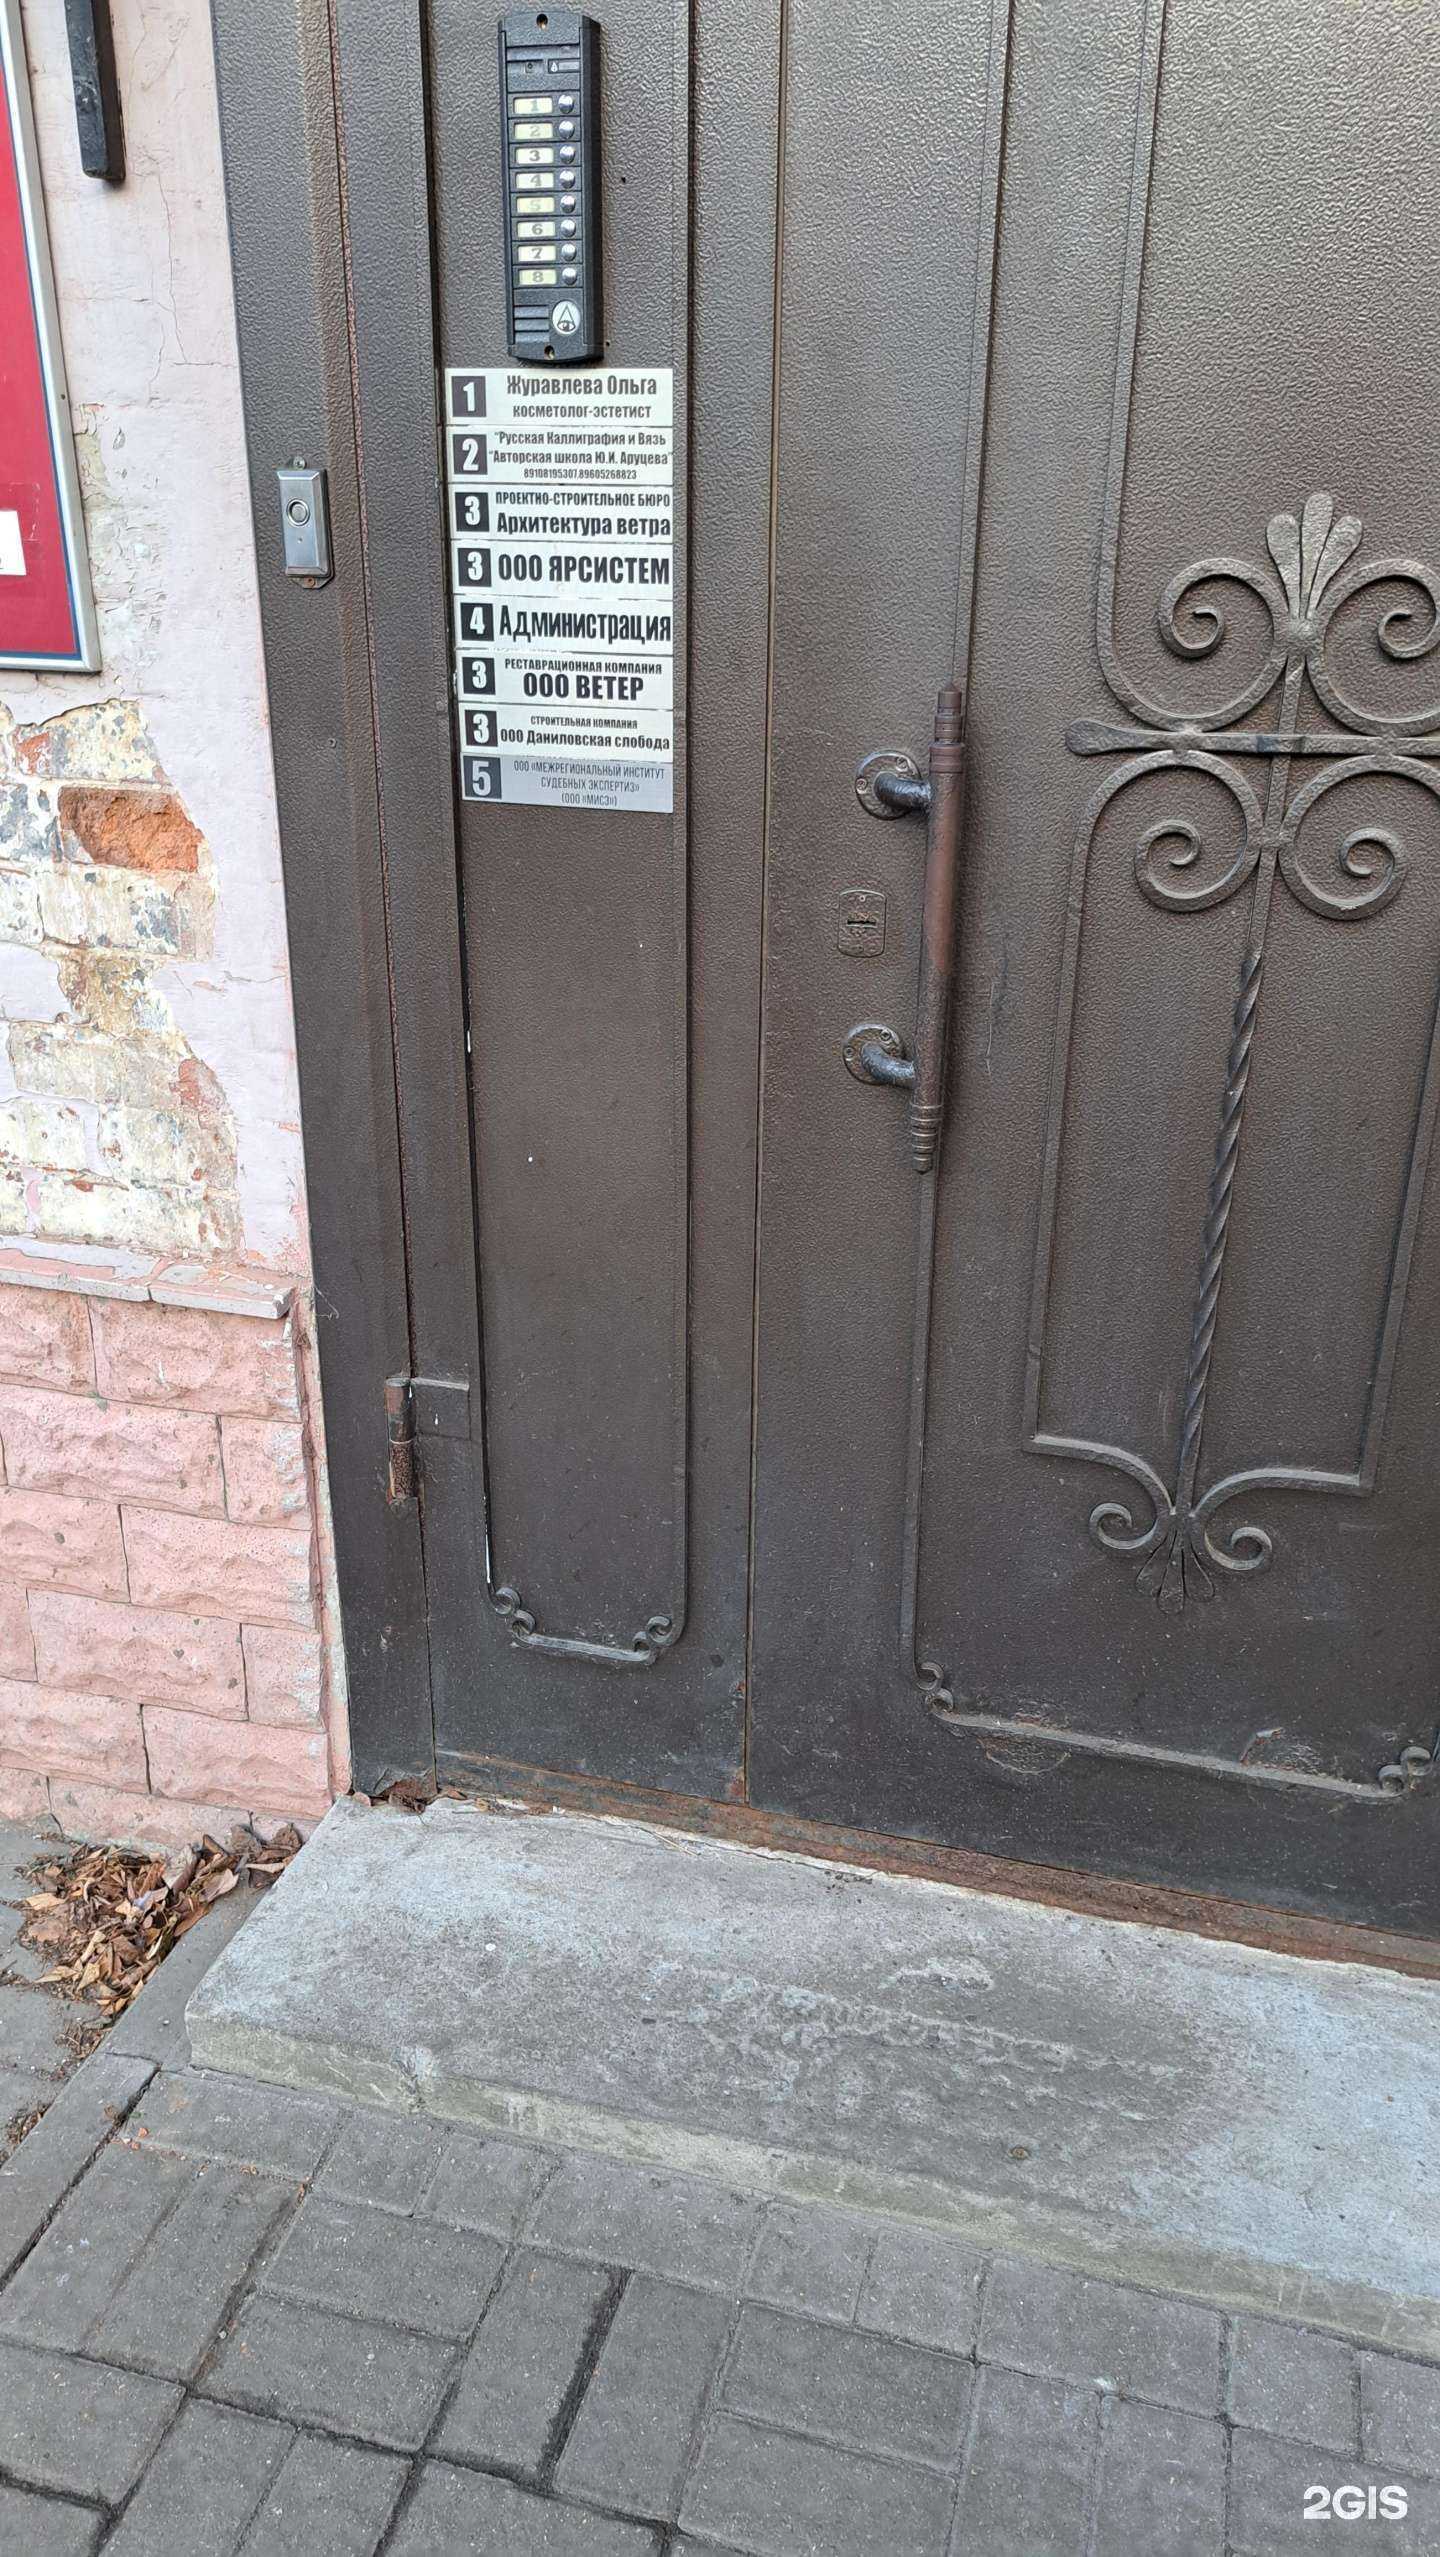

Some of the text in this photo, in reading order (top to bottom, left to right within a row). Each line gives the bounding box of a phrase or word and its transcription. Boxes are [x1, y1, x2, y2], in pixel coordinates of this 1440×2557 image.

[529, 125, 541, 137] 2
[529, 149, 541, 162] 3
[530, 174, 542, 187] 4
[531, 223, 543, 235] 6
[531, 247, 543, 259] 7
[532, 271, 544, 283] 8
[507, 375, 657, 397] Журавлева Ольга
[462, 381, 475, 412] 1
[513, 405, 651, 419] косметолог-эстетист
[546, 432, 625, 447] Каллиграфия
[628, 434, 636, 445] и
[638, 433, 666, 446] Вязь
[462, 438, 479, 471] 2
[554, 453, 593, 464] школа
[595, 451, 619, 464] Ю.И.
[495, 491, 671, 507] ПРОЕКТНО-СТРОИТЕЛЬНОЕ БЮРО
[464, 496, 481, 526] 3
[497, 512, 671, 538] Архитектура ветра
[467, 551, 484, 582] 3
[498, 554, 670, 585] ООО ЯРСИСТЕМ
[469, 606, 486, 635] 4
[500, 604, 671, 645] Администрация
[471, 660, 487, 690] 3
[504, 658, 662, 675] РЕСТАВРАЦИОННАЯ КОМПАНИЯ
[523, 672, 644, 701] ООО ВЕТЕР
[473, 713, 490, 744] 3
[530, 715, 638, 729] СТРОИТЕЛЬНАЯ КОМПАНИЯ
[500, 729, 670, 750] ООО Даниловская слобода
[472, 760, 492, 797] 5
[514, 760, 665, 780] ООО «МЕЖРЕГИОНАЛЬНЫЙ ИНСТИТУТ
[541, 776, 640, 793] СУДЕБНЫХ ЭКСПЕРТИЗ»
[561, 792, 581, 805] (ООО
